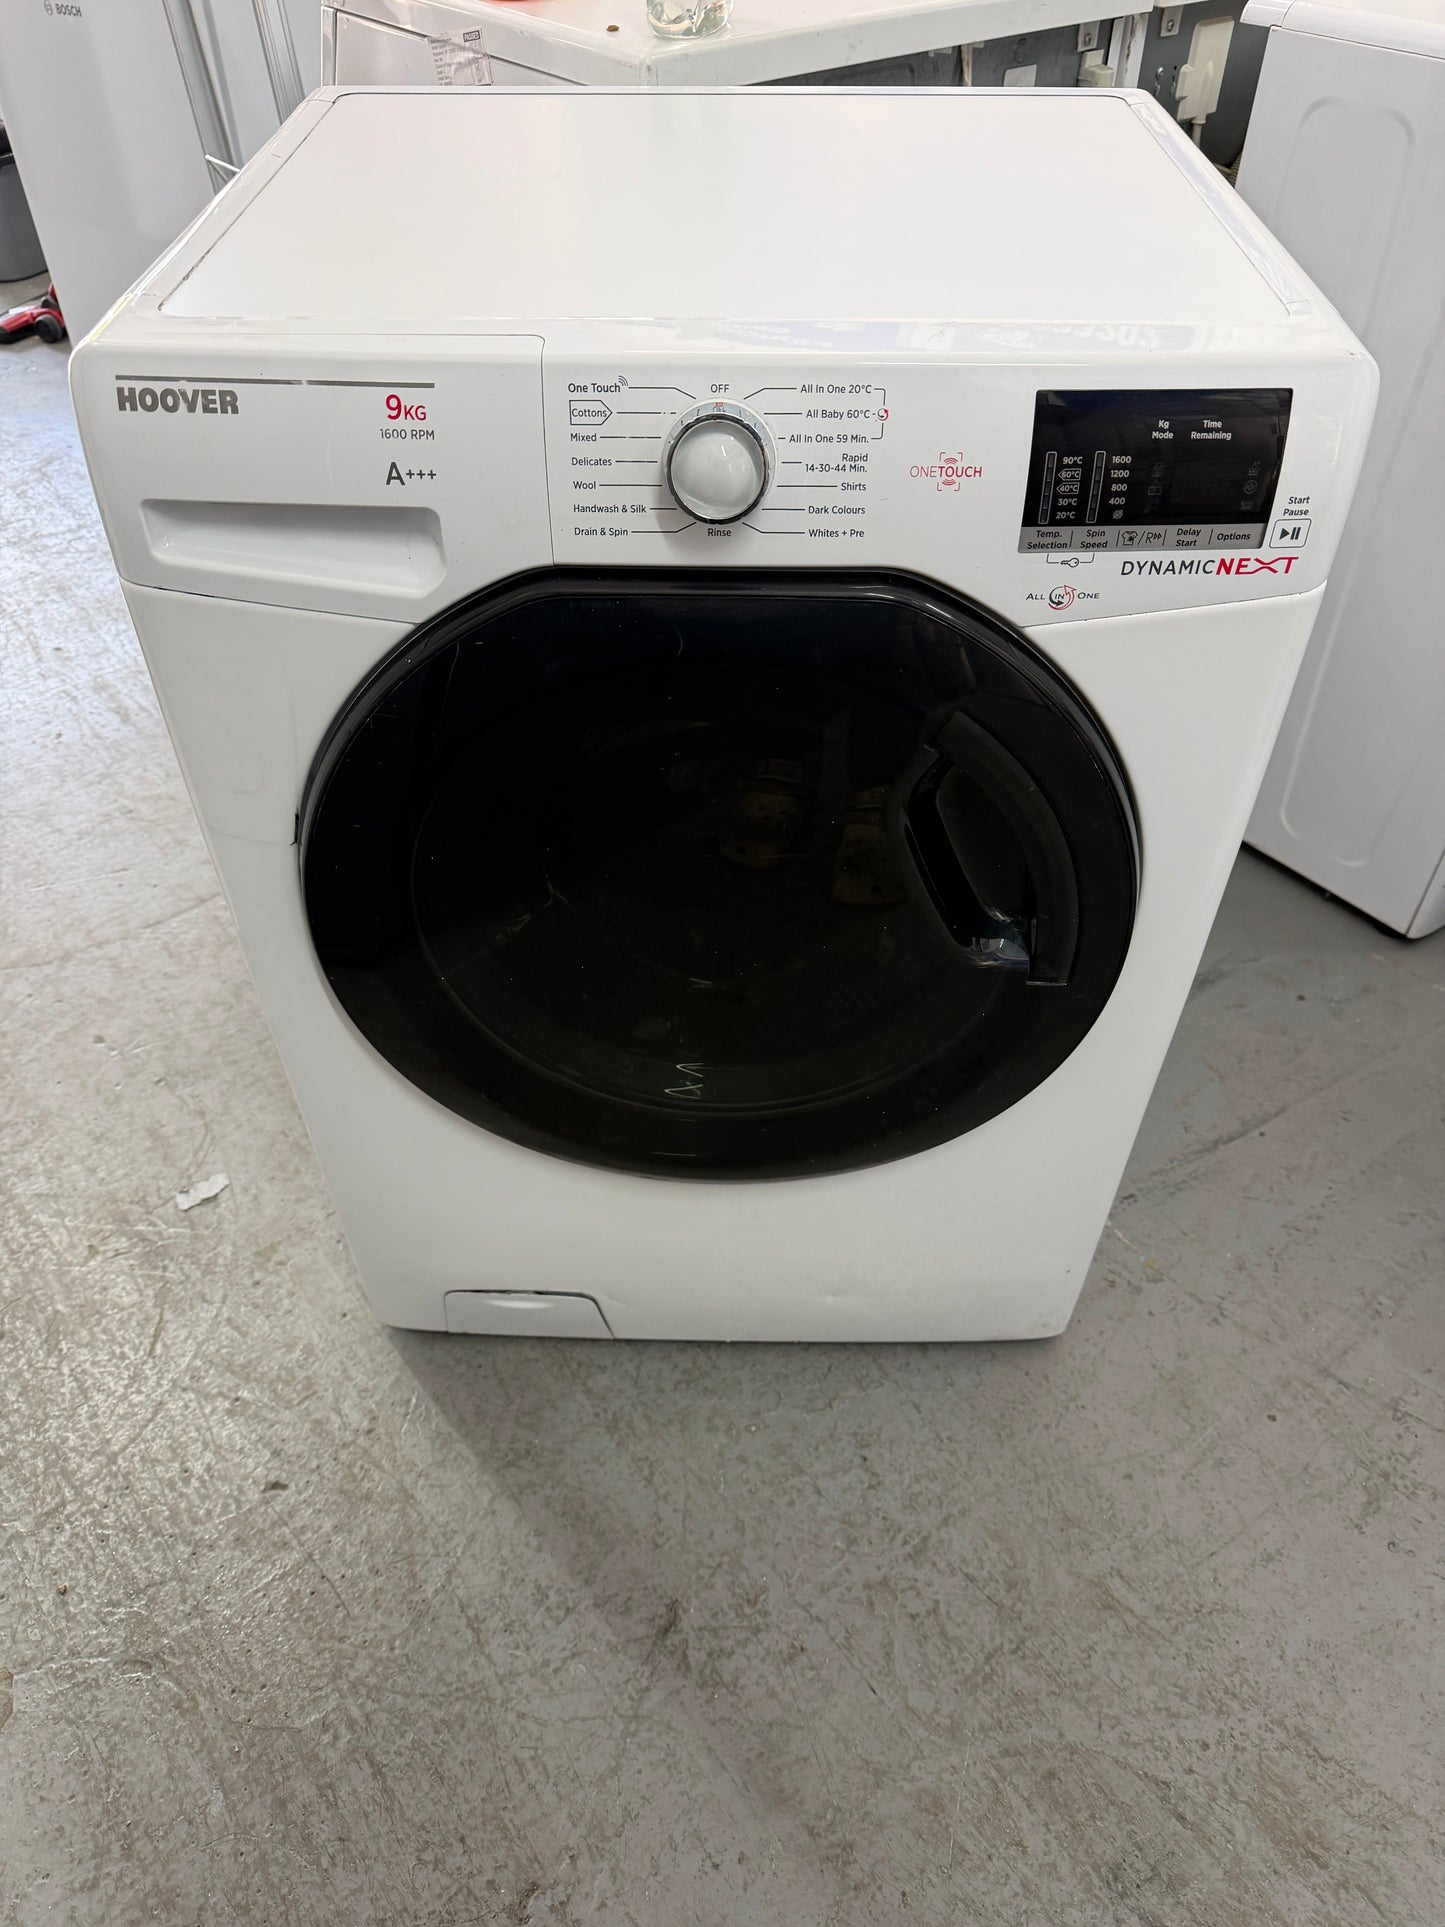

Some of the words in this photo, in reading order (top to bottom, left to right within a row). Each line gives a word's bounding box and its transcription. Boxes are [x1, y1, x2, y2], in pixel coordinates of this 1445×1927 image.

[55, 4, 82, 17] BOSCH
[568, 383, 588, 392] One
[591, 383, 621, 393] Touch
[711, 384, 729, 393] OFF
[801, 384, 812, 393] All
[816, 385, 822, 394] In
[825, 385, 846, 394] One
[849, 385, 871, 393] 20°C
[117, 387, 239, 415] HOOVER
[386, 394, 426, 420] 9KG
[571, 407, 607, 418] Cottons
[806, 409, 818, 418] All
[822, 410, 844, 420] Baby
[846, 409, 870, 419] 60°C
[1159, 420, 1169, 429] Kg
[1203, 420, 1222, 428] Time
[380, 429, 407, 439] 1600
[411, 429, 434, 440] RPM
[571, 433, 596, 441] Mixed
[789, 434, 801, 442] All
[805, 434, 812, 442] In
[816, 434, 833, 443] One
[837, 434, 848, 443] 59
[851, 434, 868, 443] Min.
[1152, 431, 1173, 439] Mode
[1191, 431, 1231, 440] Remaining
[572, 457, 612, 466] Delicates
[842, 453, 868, 463] Rapid
[806, 464, 846, 472] 14-30-44
[849, 463, 868, 473] Min.
[910, 466, 982, 477] ONETOUCH
[386, 462, 436, 485] A+++
[1061, 471, 1080, 479] 60°C
[573, 481, 596, 489] Wool
[841, 482, 866, 491] Shirts
[1059, 483, 1078, 492] 40°C
[1288, 496, 1310, 504] Start
[574, 504, 619, 513] Handwash
[622, 505, 627, 513] &
[631, 505, 646, 513] Silk
[809, 506, 829, 514] Dark
[832, 506, 865, 514] Colours
[575, 527, 597, 535] Drain
[600, 528, 606, 536] &
[609, 528, 628, 537] Spin
[708, 528, 731, 536] Rinse
[809, 529, 839, 537] Whites
[850, 529, 864, 537] Pre
[1036, 530, 1062, 539] Temp.
[1086, 529, 1105, 538] Spin
[1177, 528, 1201, 536] Delay
[1217, 533, 1250, 541] Options
[1028, 542, 1068, 550] Selection
[1080, 541, 1107, 549] Speed
[1053, 592, 1065, 600] IN
